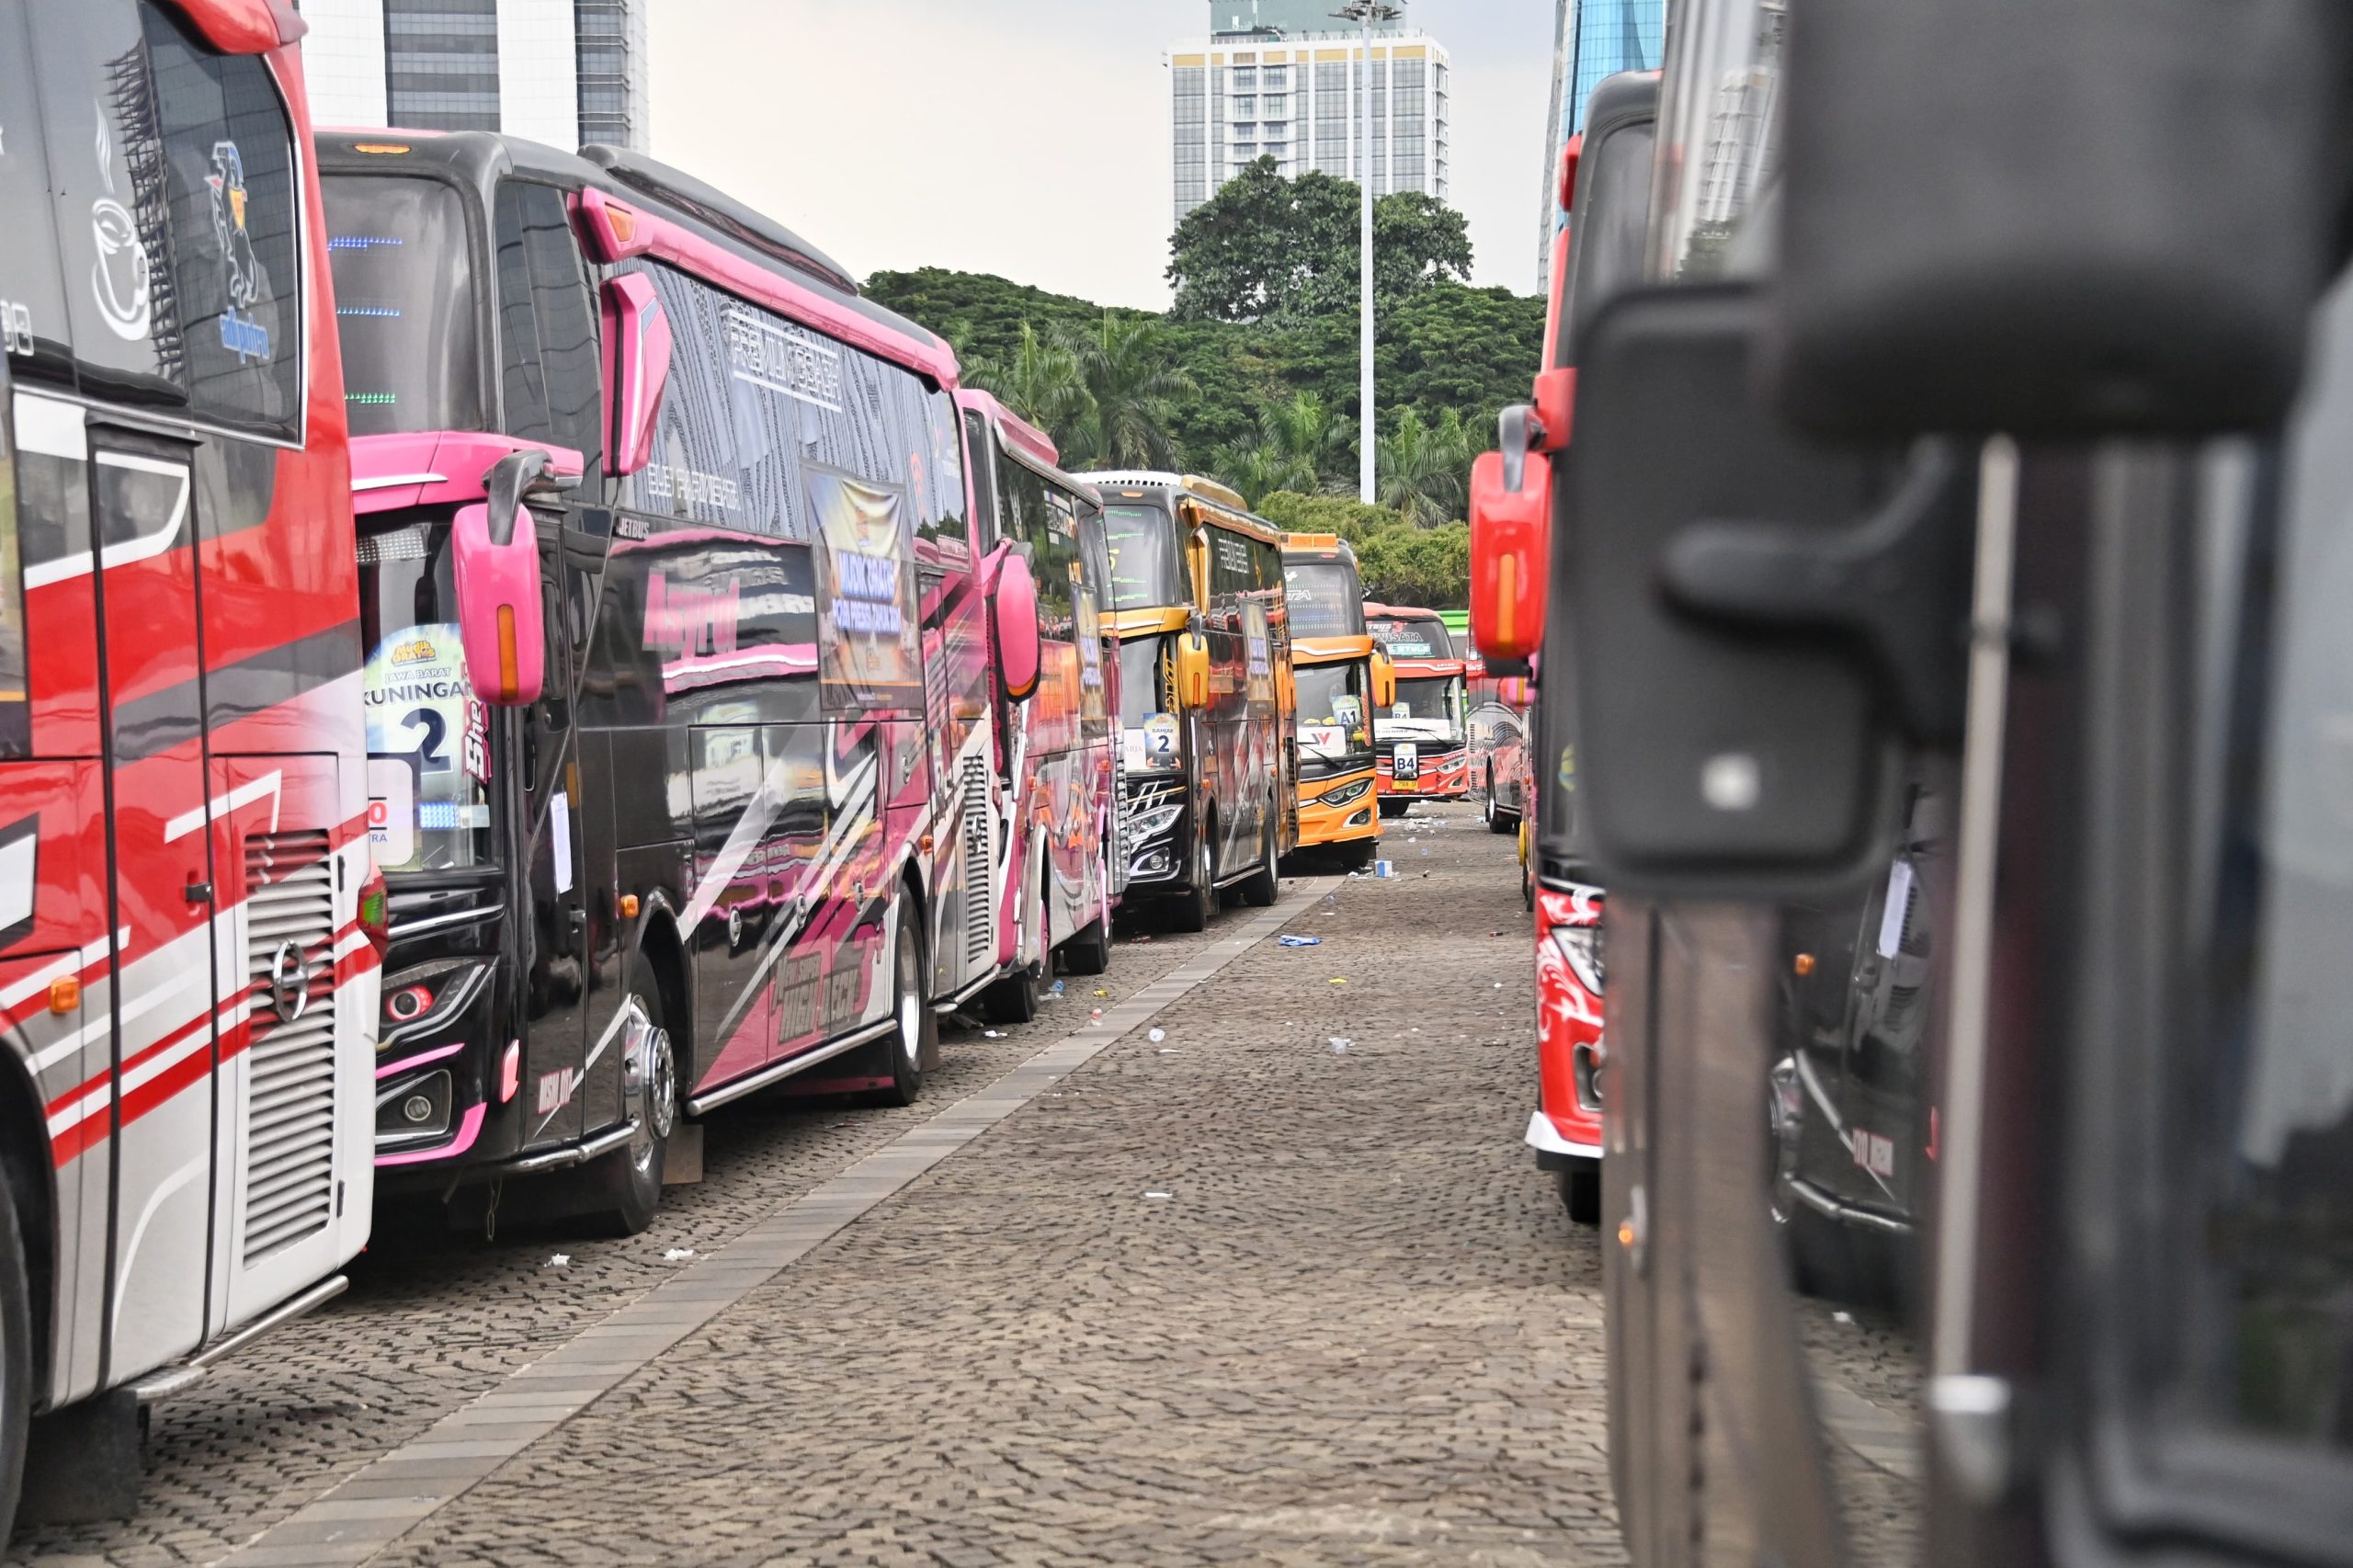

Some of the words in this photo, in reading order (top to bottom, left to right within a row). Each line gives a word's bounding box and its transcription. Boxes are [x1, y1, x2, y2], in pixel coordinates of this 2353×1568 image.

[617, 517, 650, 540] JETBUS
[385, 670, 414, 684] JAWA
[415, 667, 451, 679] BARAT
[1340, 710, 1358, 724] A1
[401, 708, 453, 775] 2
[1157, 734, 1170, 753] 2
[1396, 757, 1415, 770] B4
[779, 978, 820, 1045] HIGH
[817, 966, 861, 1028] DECK
